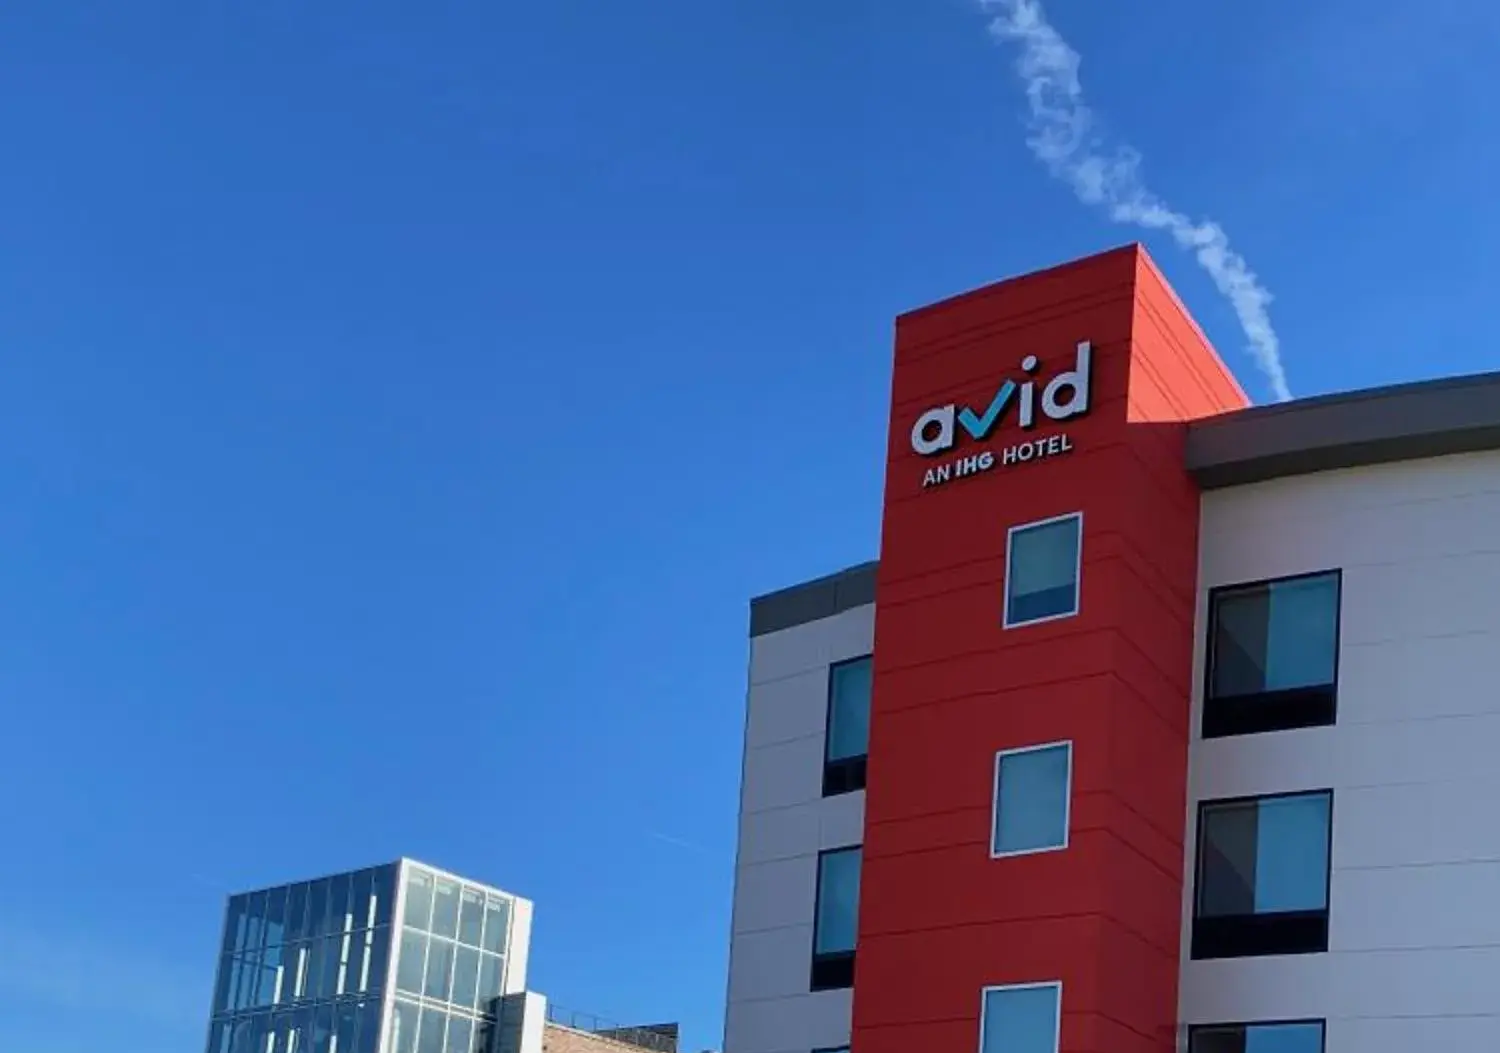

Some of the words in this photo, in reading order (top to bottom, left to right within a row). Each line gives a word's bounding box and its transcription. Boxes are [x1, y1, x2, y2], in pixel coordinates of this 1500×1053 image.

[911, 340, 1092, 455] avid
[922, 464, 951, 487] AN
[956, 452, 994, 478] IHG
[1002, 434, 1073, 465] HOTEL
